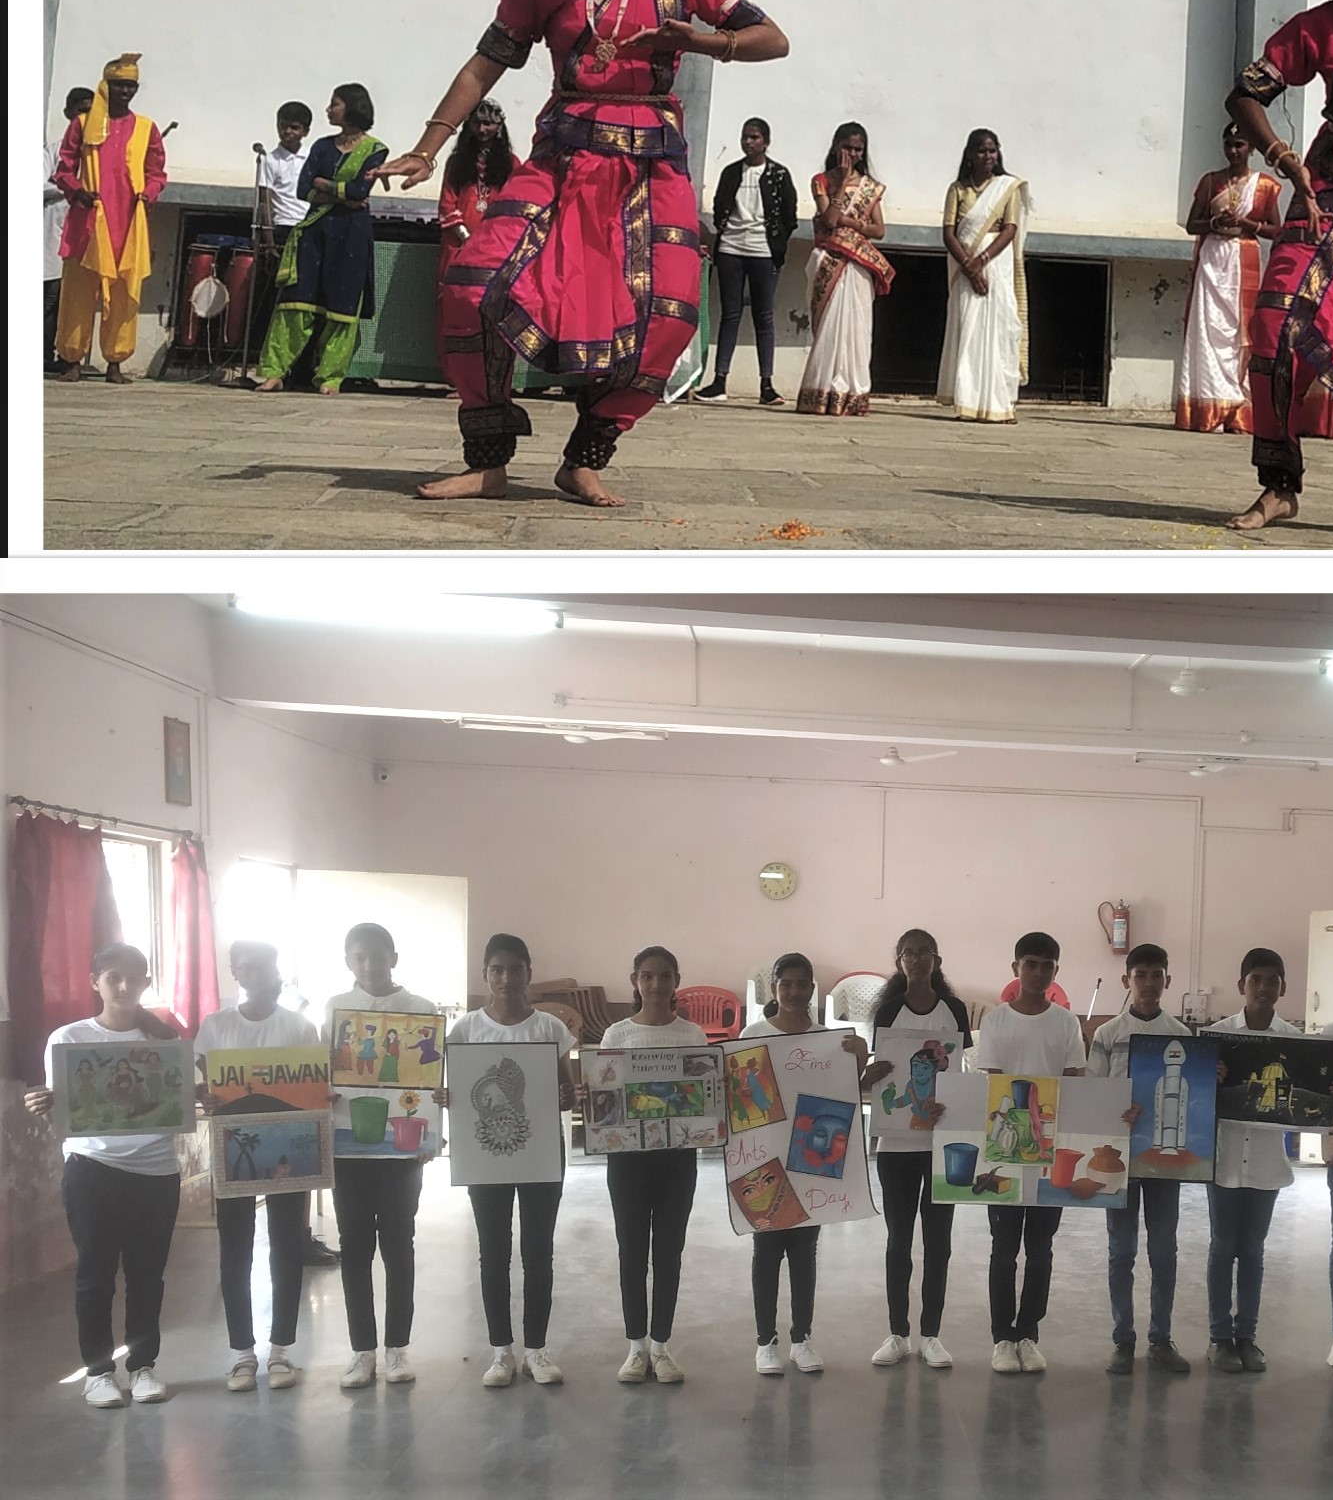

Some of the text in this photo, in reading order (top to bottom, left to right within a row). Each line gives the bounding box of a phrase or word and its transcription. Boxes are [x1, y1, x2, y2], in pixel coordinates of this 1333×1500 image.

[212, 1063, 329, 1087] JAI JAWAN
[727, 1134, 767, 1166] Arts
[805, 1187, 852, 1214] Day
